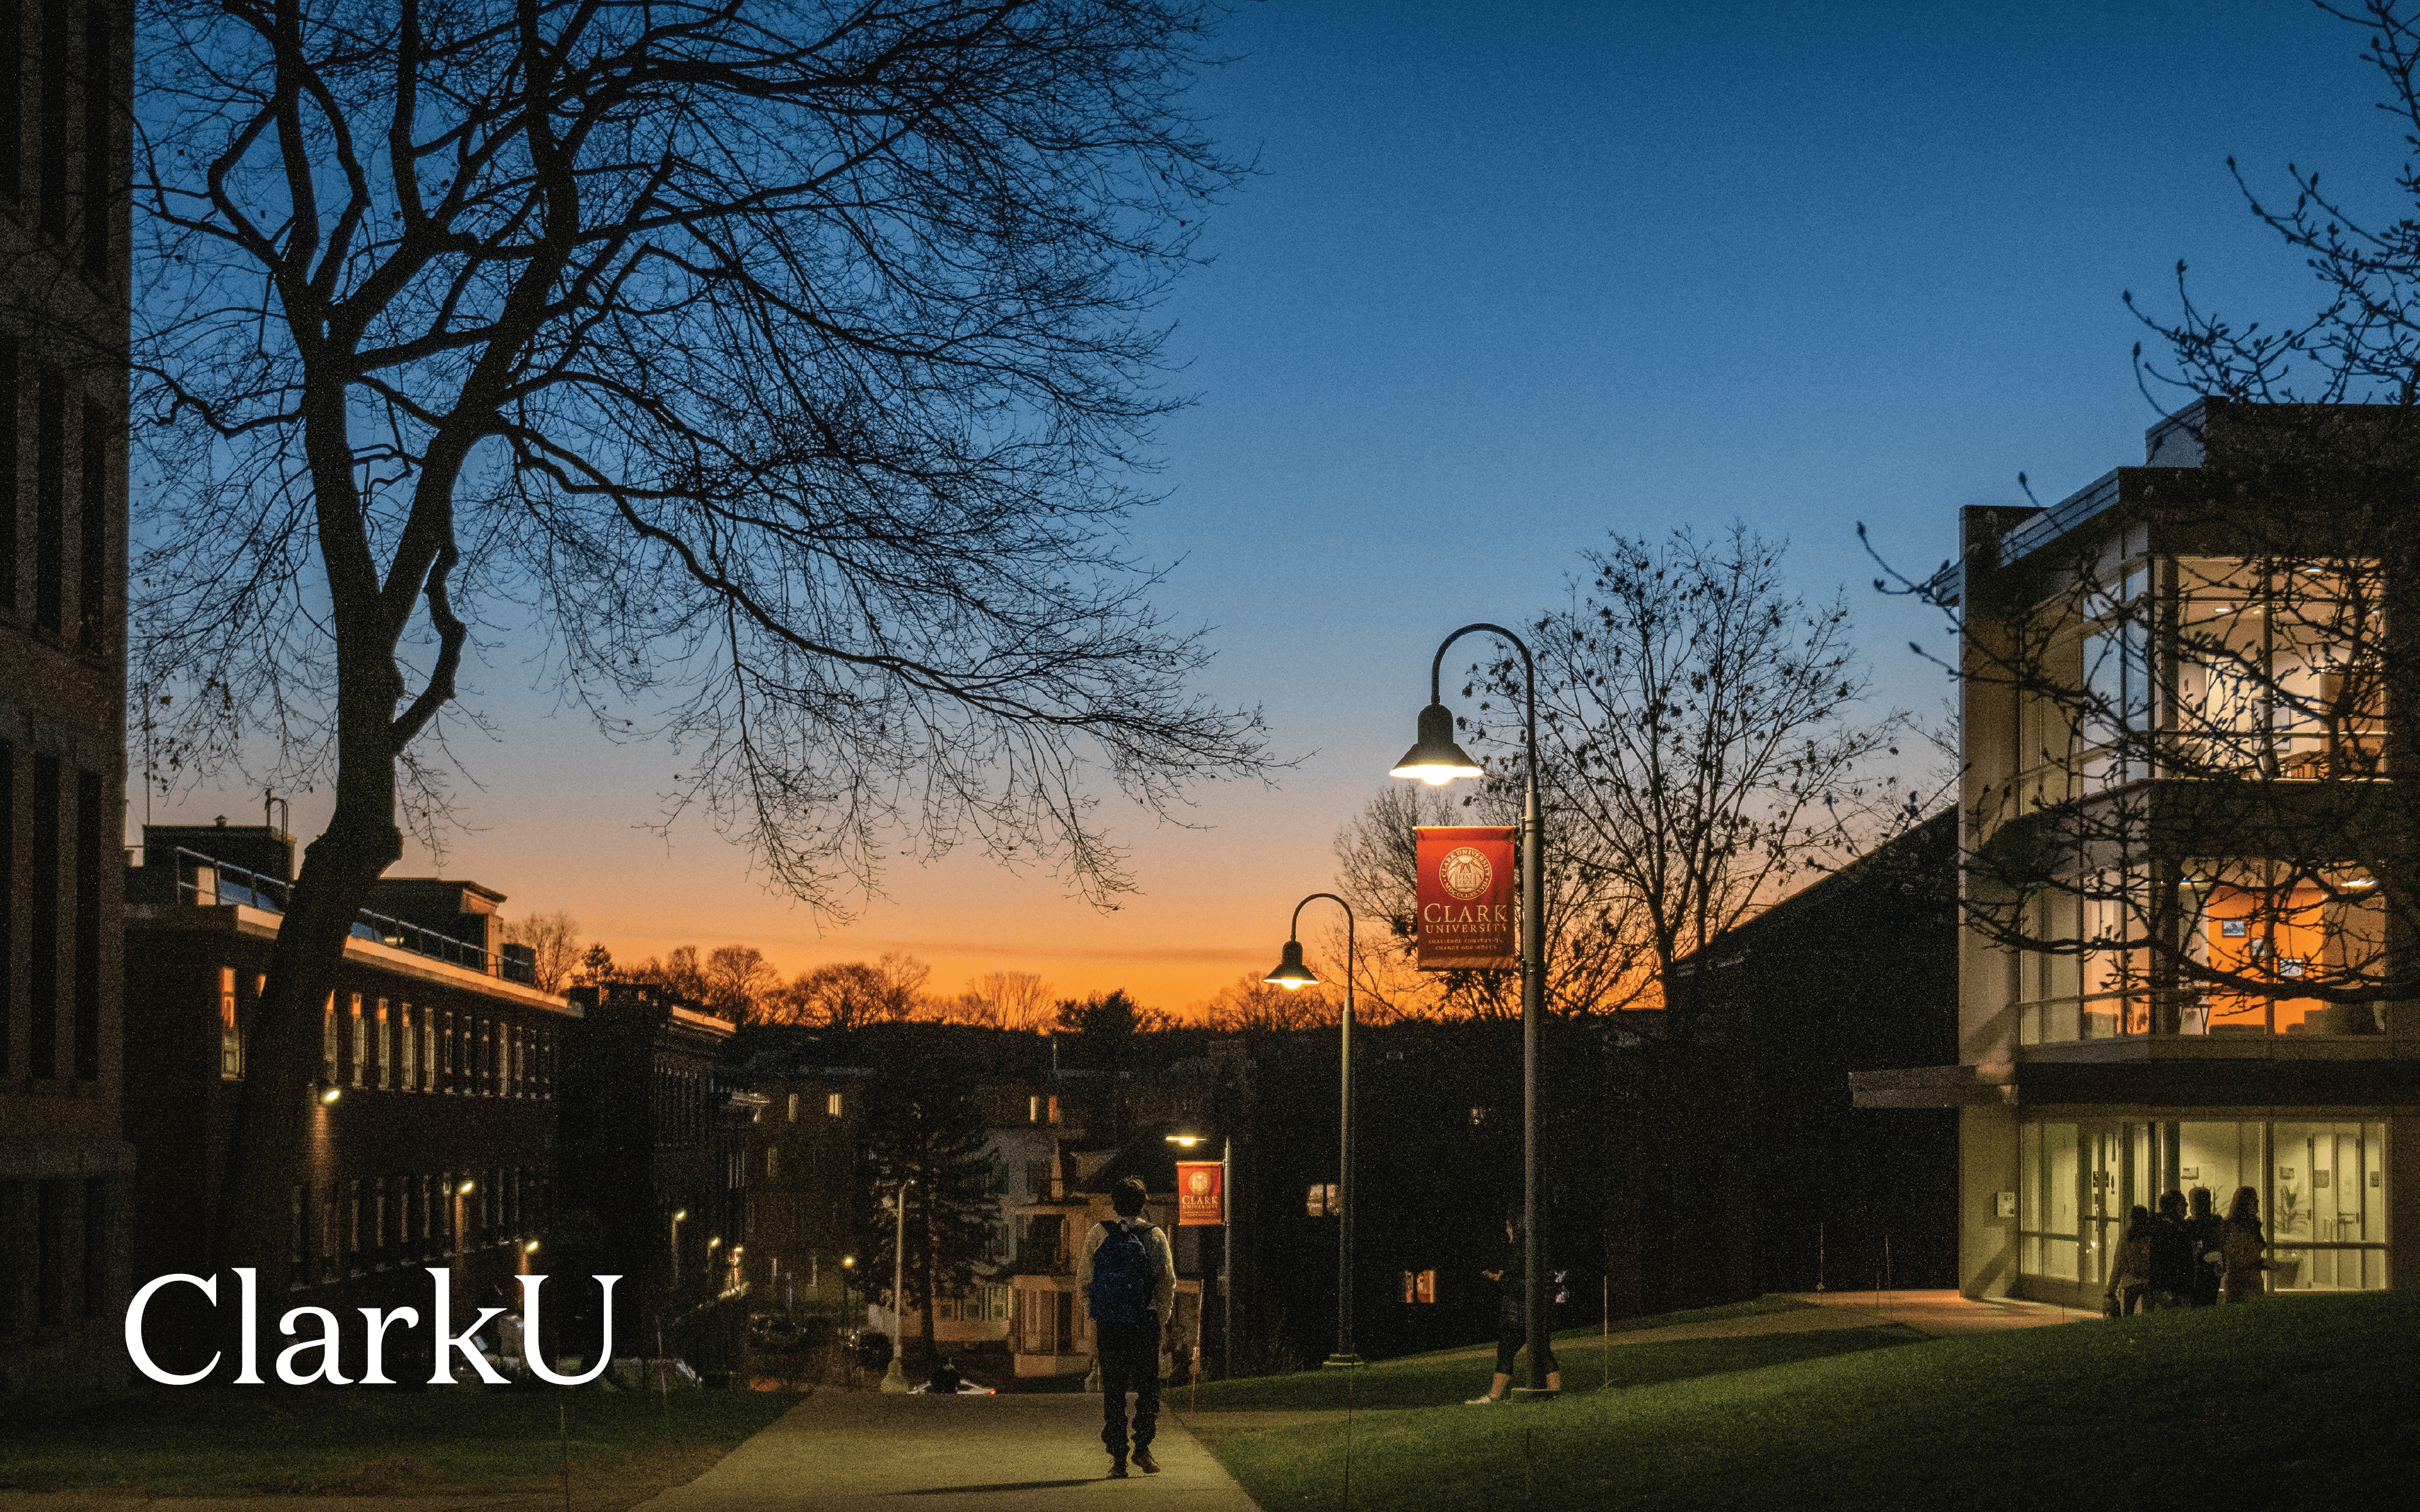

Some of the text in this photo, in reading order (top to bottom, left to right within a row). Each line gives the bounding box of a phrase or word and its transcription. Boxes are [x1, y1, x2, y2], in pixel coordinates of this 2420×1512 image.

[1441, 849, 1490, 878] CLARK UNIVERSITY
[1424, 903, 1507, 923] CLARK
[1426, 924, 1507, 934] UNIVERSITY
[1182, 1196, 1218, 1205] CLARK
